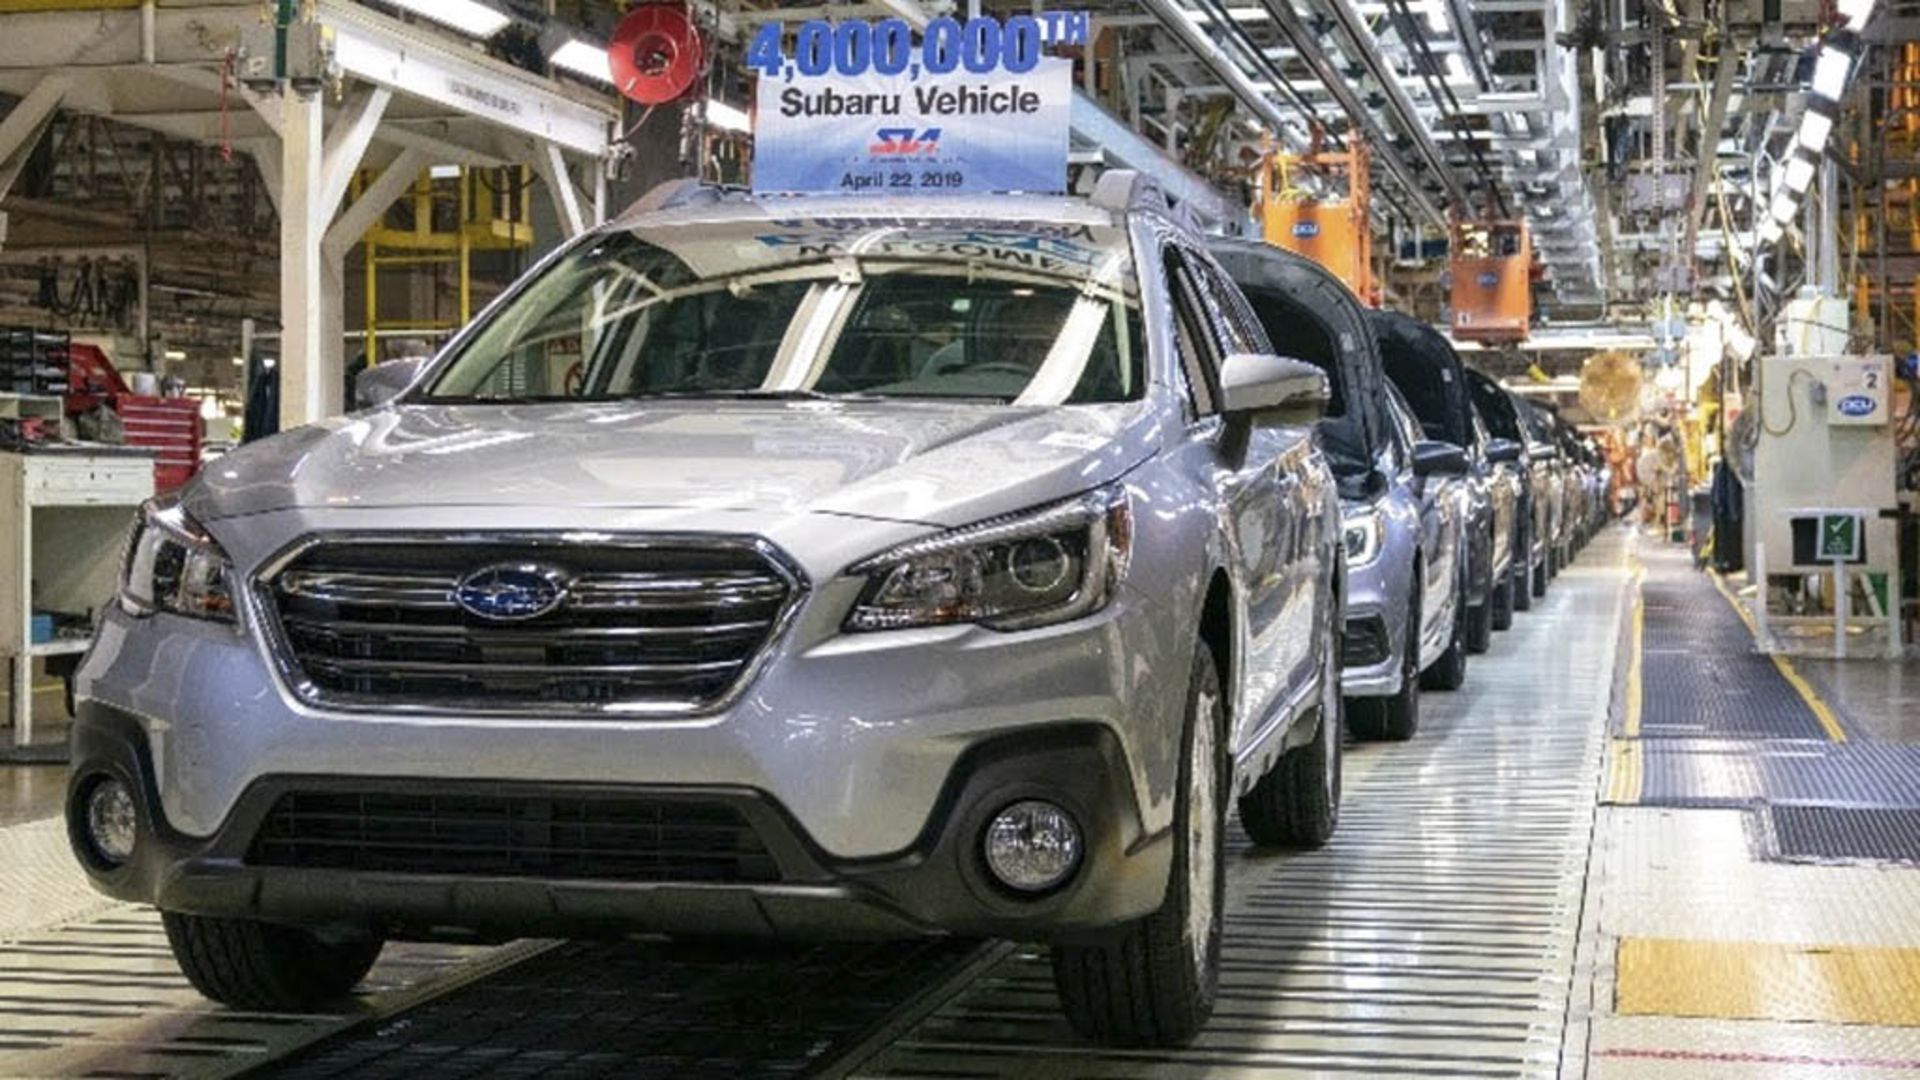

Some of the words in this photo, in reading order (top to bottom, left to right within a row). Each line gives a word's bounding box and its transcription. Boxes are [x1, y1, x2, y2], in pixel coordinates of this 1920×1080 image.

[780, 87, 900, 117] Subaru
[915, 85, 1040, 115] Vehicle
[840, 172, 883, 191] April
[921, 171, 963, 188] 2019
[1866, 372, 1877, 390] 2
